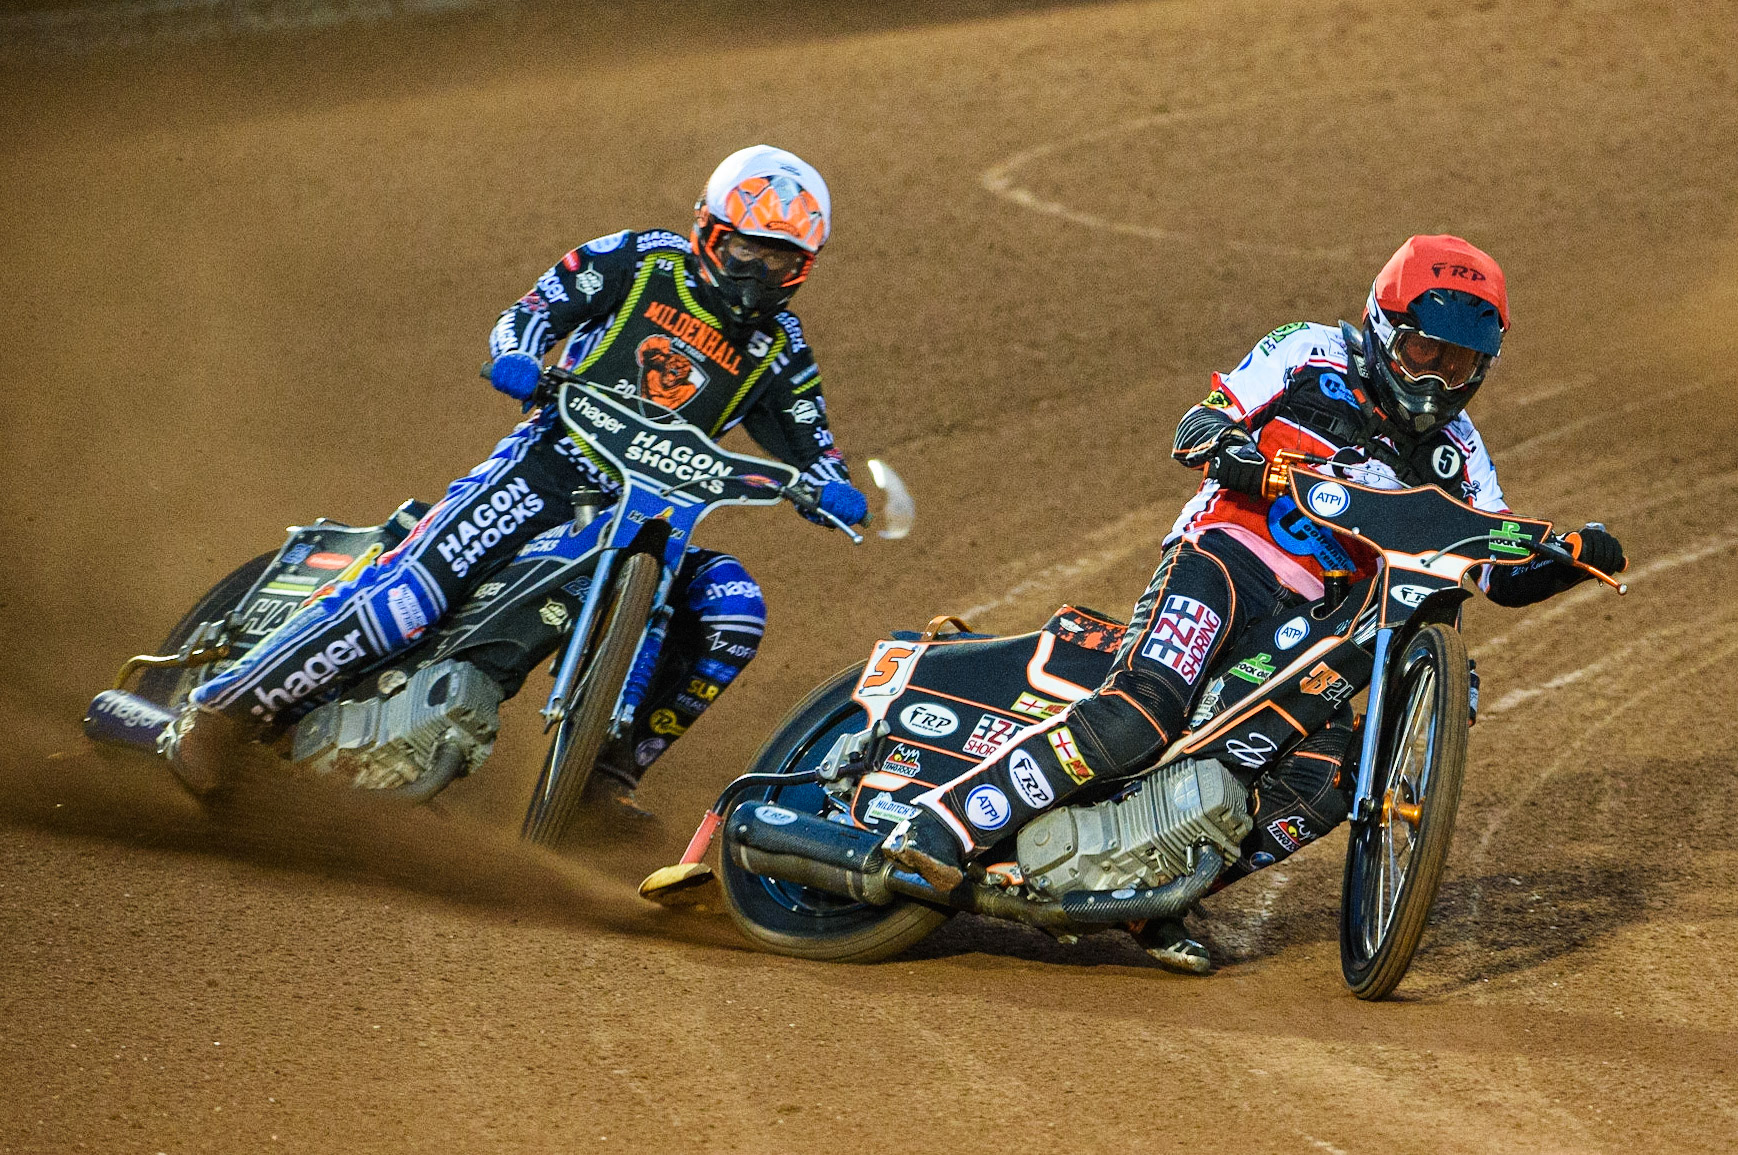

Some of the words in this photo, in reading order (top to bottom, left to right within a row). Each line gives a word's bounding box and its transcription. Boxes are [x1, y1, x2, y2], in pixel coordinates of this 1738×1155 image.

[644, 301, 743, 376] MILDENHALL
[747, 330, 773, 357] 5
[624, 445, 726, 495] SHOCKS
[631, 430, 735, 478] HAGON
[1438, 446, 1455, 475] 5
[436, 476, 531, 563] HAGON
[1315, 491, 1342, 506] ATPI
[450, 493, 545, 578] SHOCKS
[1180, 609, 1220, 684] SHORING
[1281, 626, 1303, 640] ATPI
[863, 647, 916, 688] 5
[909, 706, 952, 729] FRP
[1012, 757, 1050, 803] FRP
[976, 794, 1001, 822] ATPI
